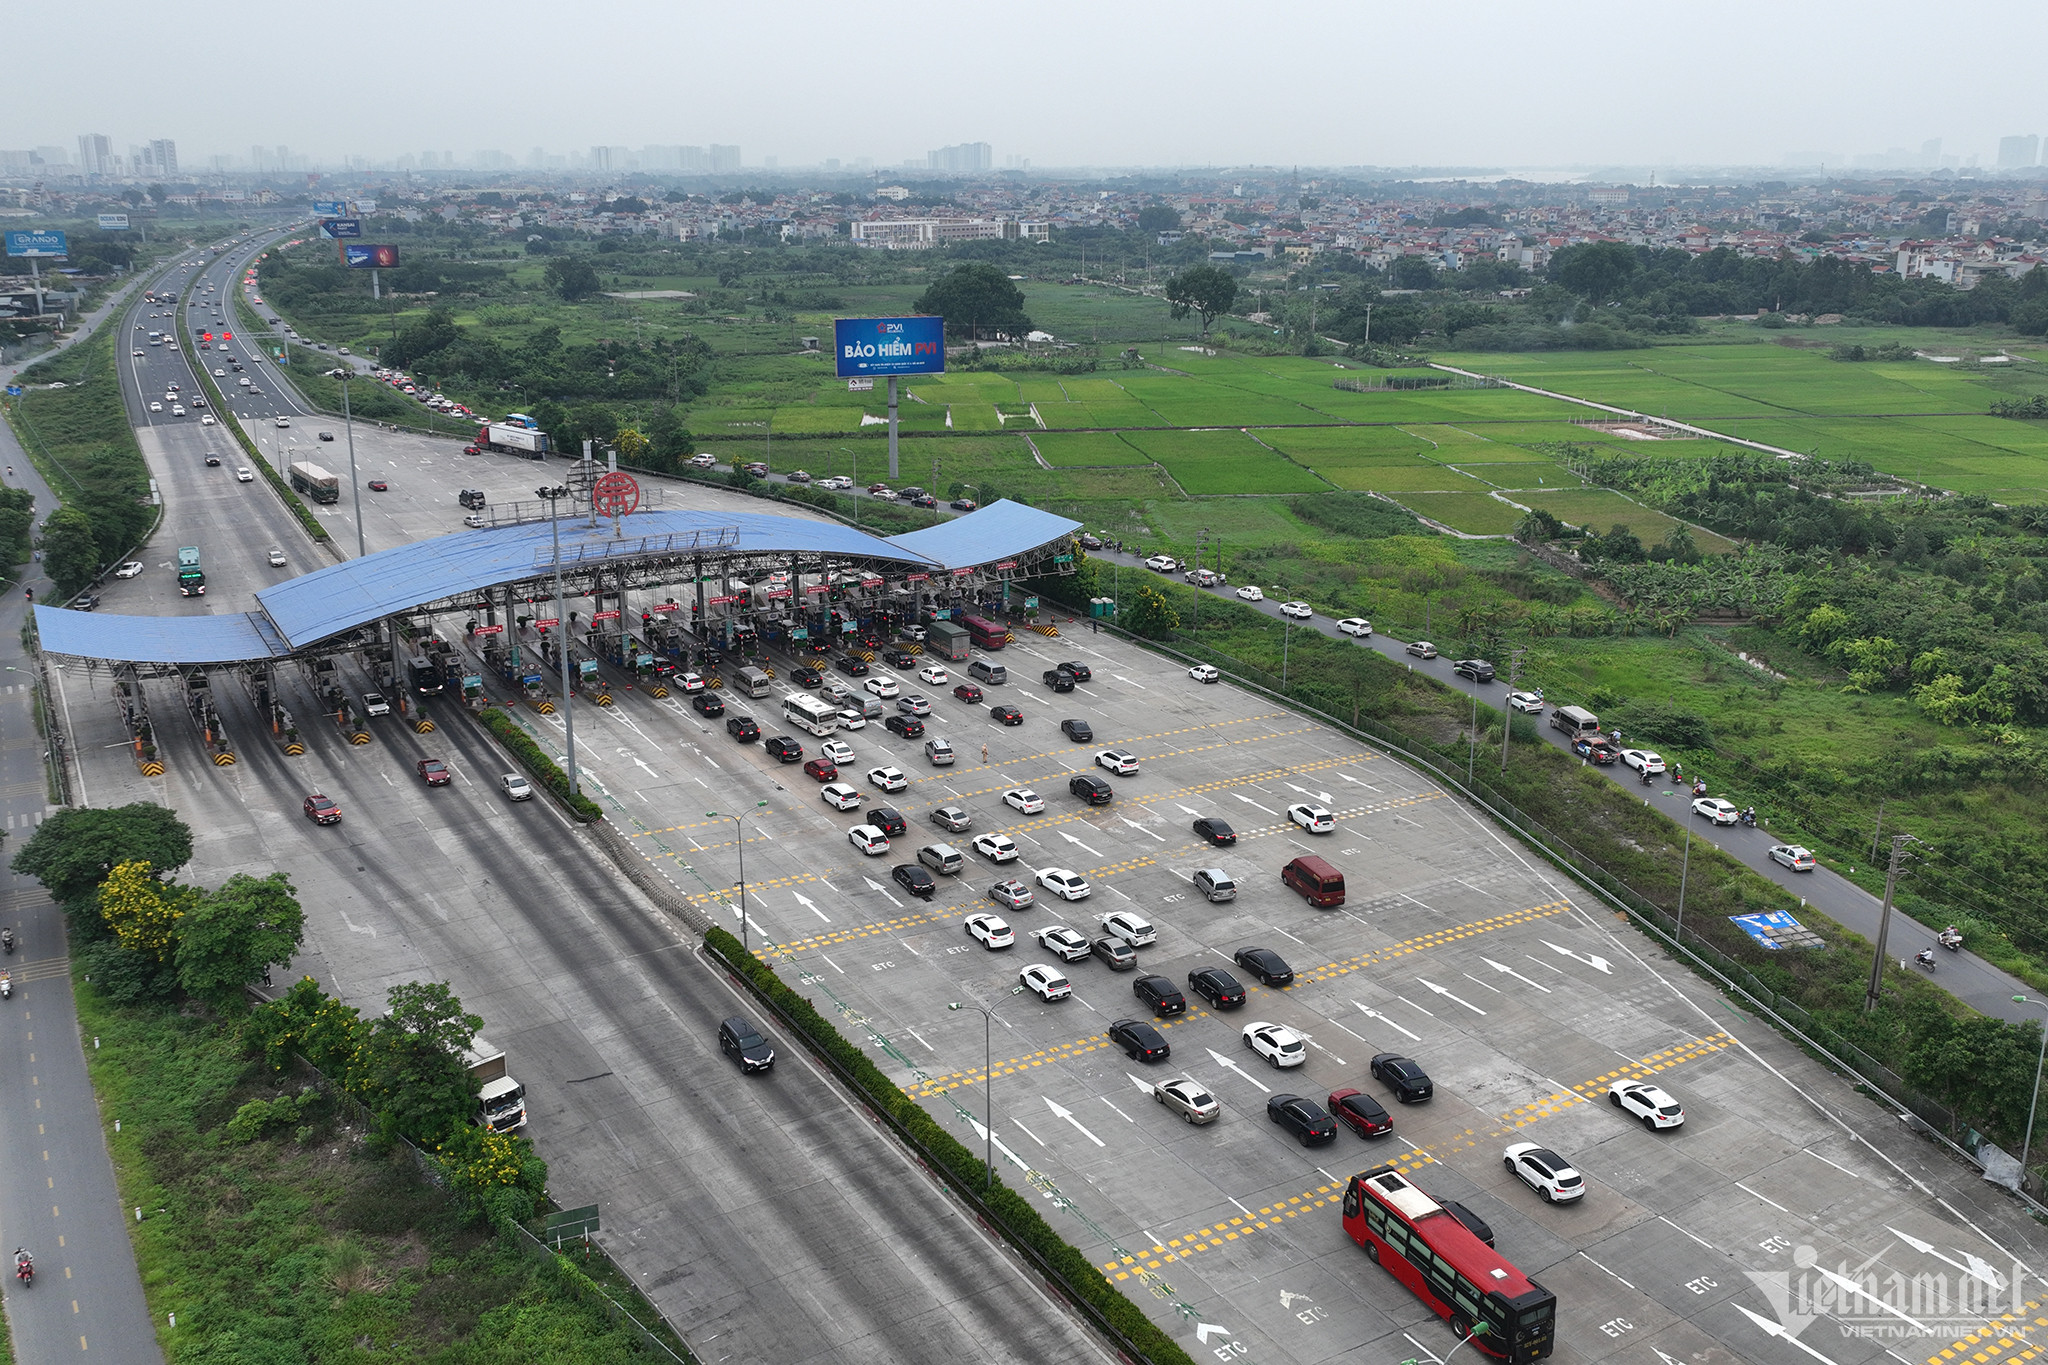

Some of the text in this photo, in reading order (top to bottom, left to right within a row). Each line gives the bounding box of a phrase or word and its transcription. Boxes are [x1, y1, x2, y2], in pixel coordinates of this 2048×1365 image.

[887, 323, 902, 331] PVI
[844, 336, 937, 358] BẢO HIỂM PVI
[1340, 847, 1361, 857] ETC
[1163, 893, 1186, 903] ETC
[946, 945, 970, 955] ETC
[871, 960, 896, 972] ETC
[800, 974, 826, 986] ETC
[1758, 1235, 1792, 1254] ETC
[1684, 1275, 1719, 1295] ETC
[1295, 1306, 1330, 1326] ETC
[1599, 1317, 1634, 1338] ETC
[1213, 1341, 1248, 1362] ETC
